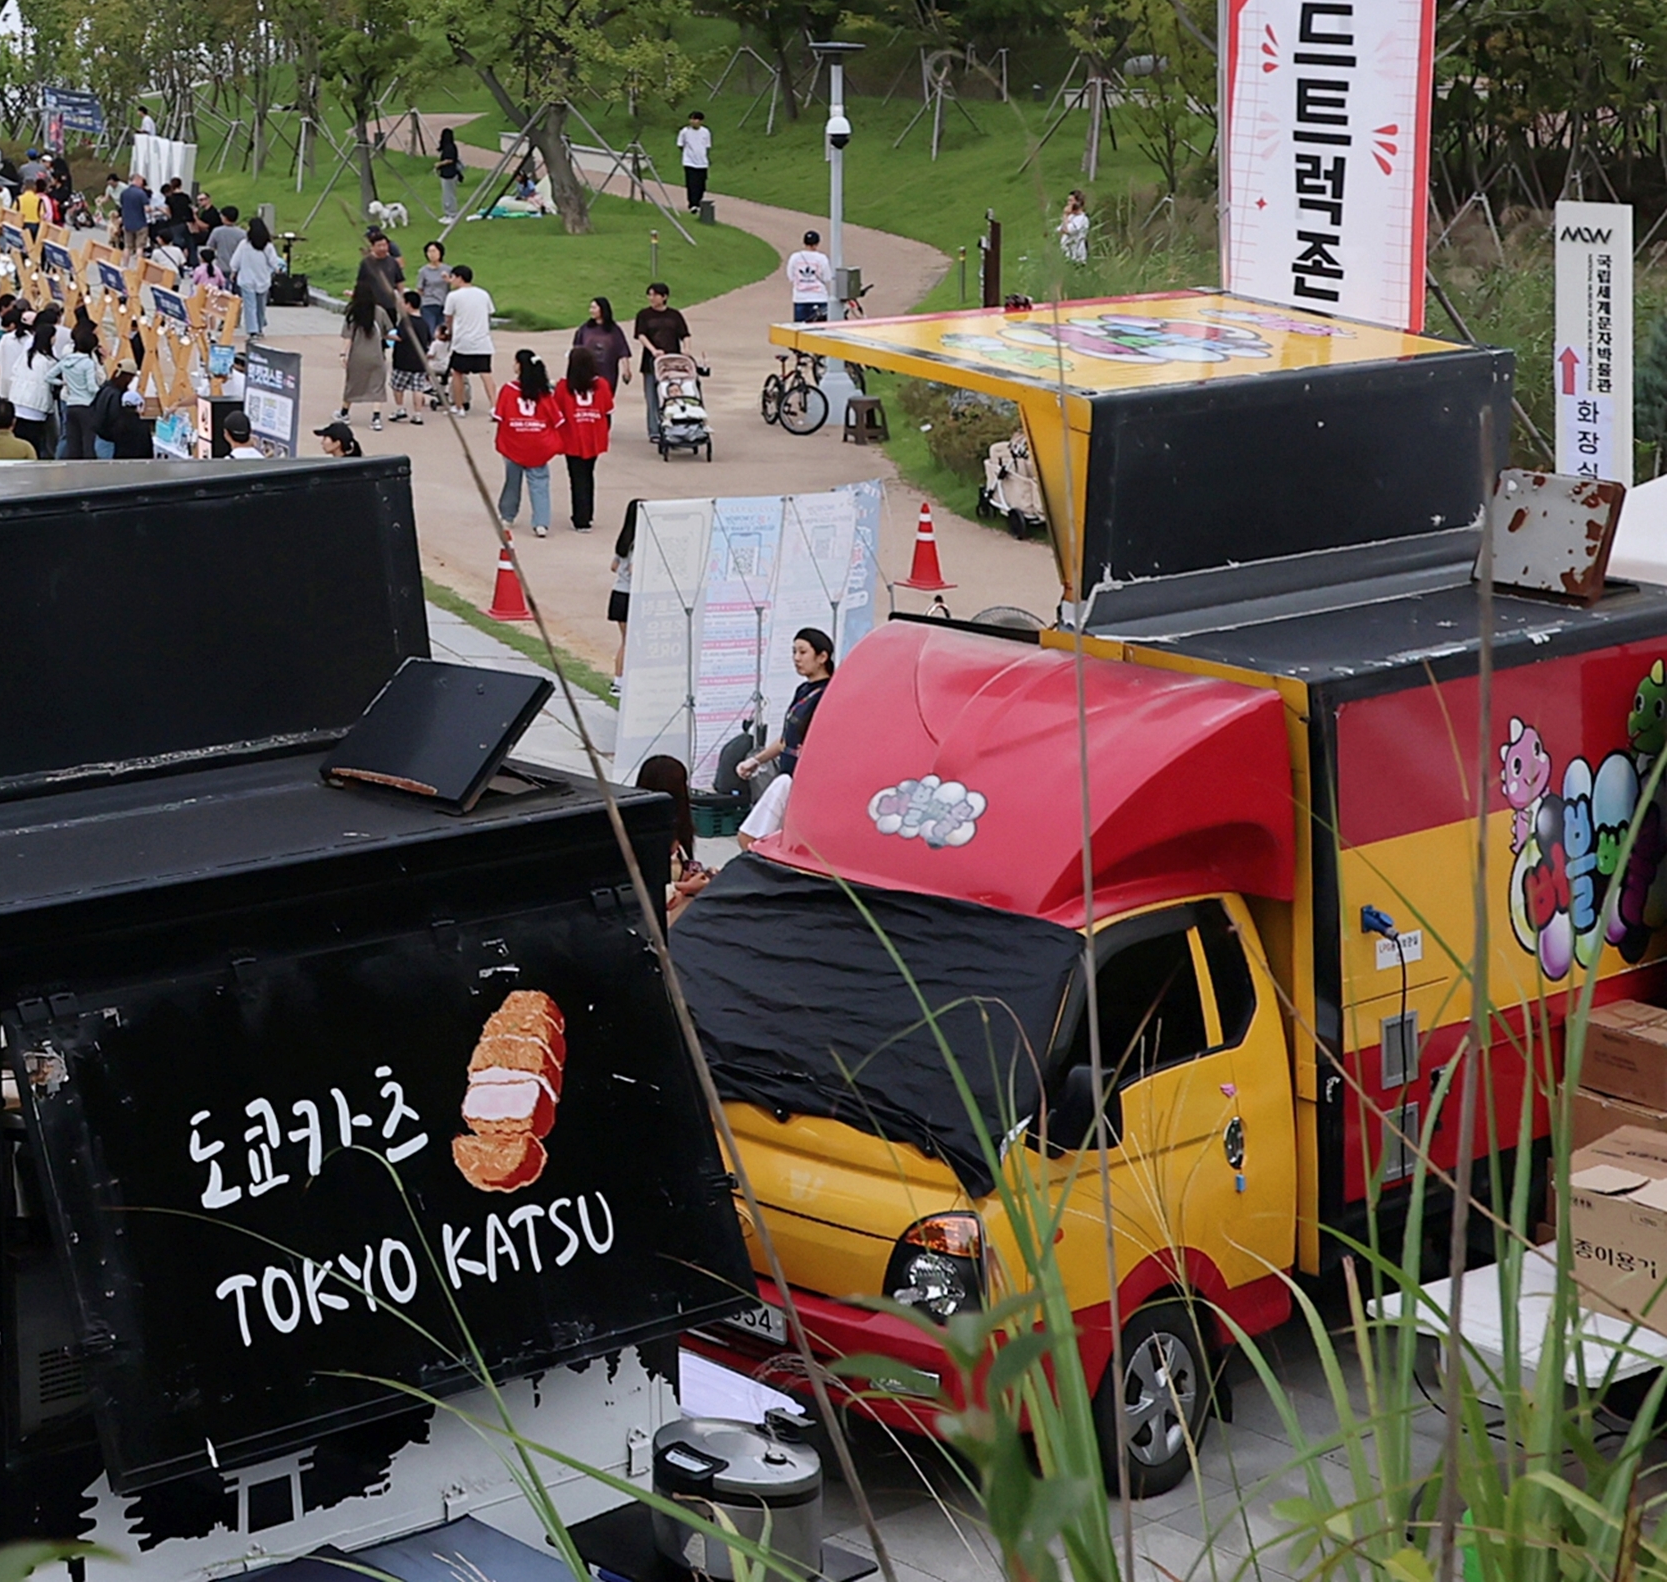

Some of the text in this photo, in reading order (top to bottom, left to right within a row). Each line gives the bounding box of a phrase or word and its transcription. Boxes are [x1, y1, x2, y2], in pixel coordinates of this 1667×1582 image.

[1596, 254, 1612, 393] 국립세계문자박물관
[189, 1065, 429, 1209] 도쿄카츠
[216, 1191, 614, 1347] TOKYO KATSU
[1574, 1237, 1656, 1279] 종이용기
